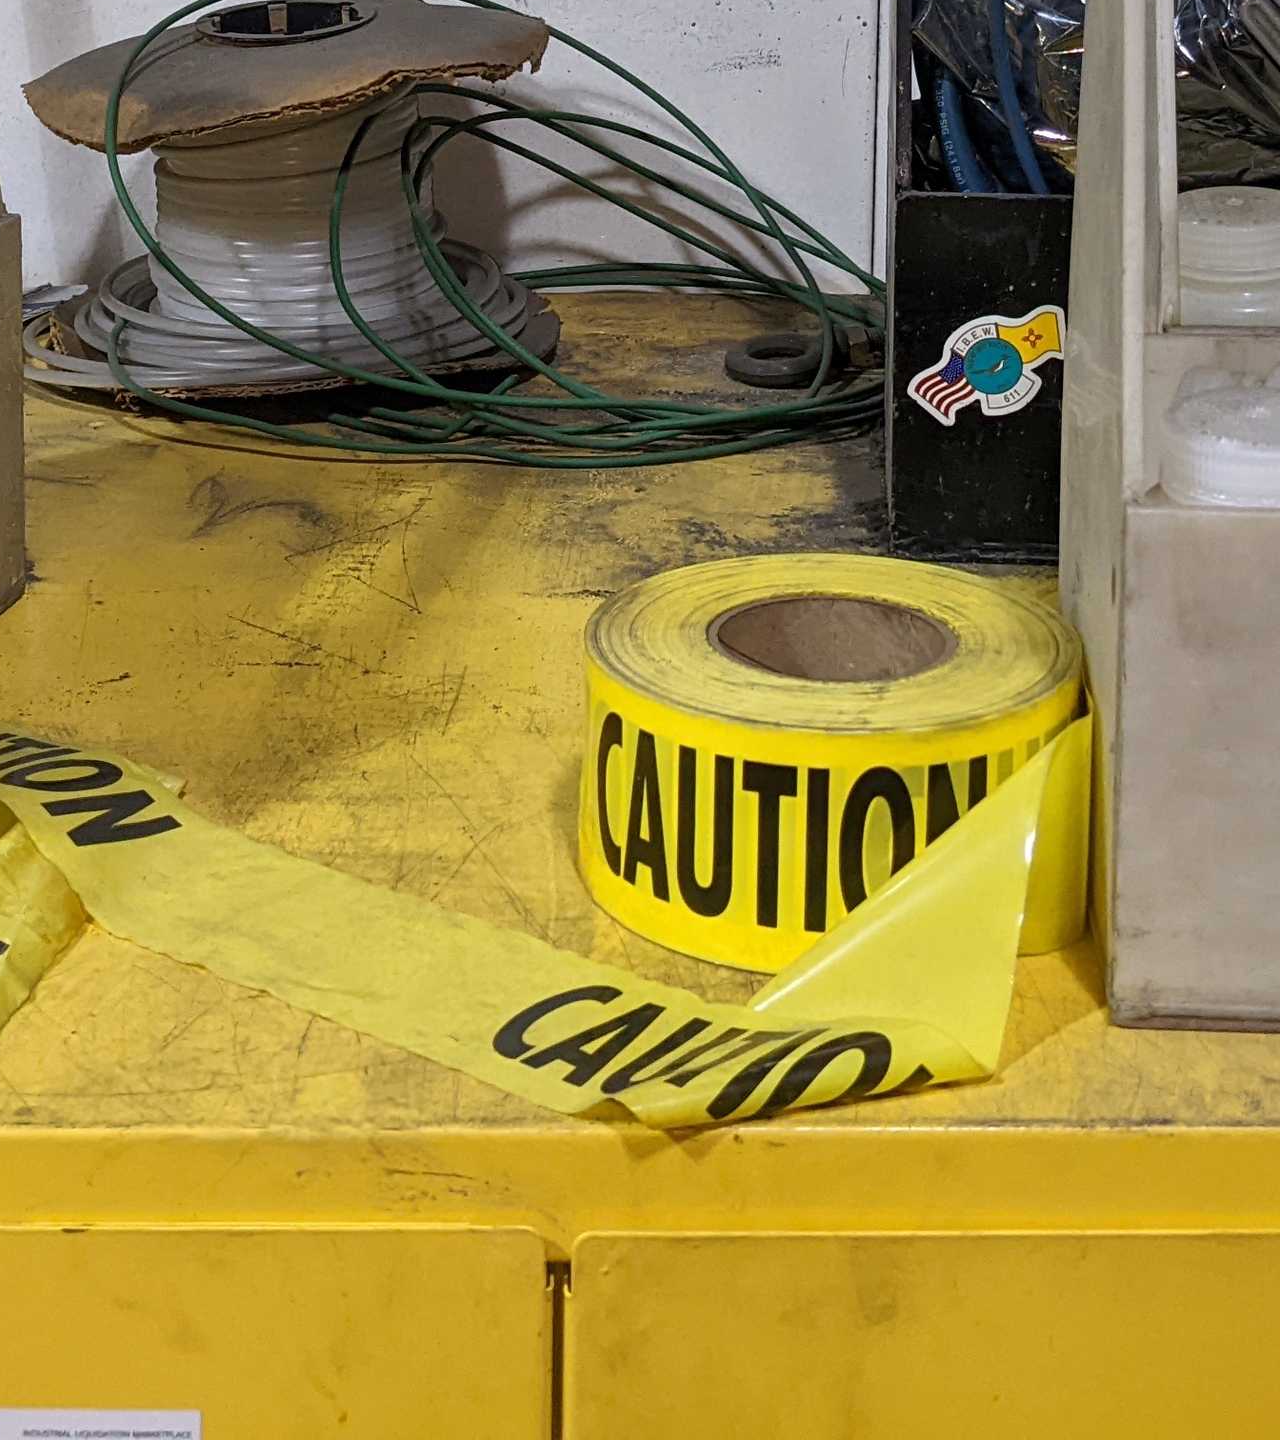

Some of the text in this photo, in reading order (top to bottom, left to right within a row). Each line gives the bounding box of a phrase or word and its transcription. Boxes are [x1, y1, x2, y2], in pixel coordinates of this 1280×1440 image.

[939, 112, 950, 136] PSIG
[955, 326, 996, 355] I.B.E.W.
[1003, 388, 1022, 404] 611
[492, 984, 936, 1120] CAUTIO
